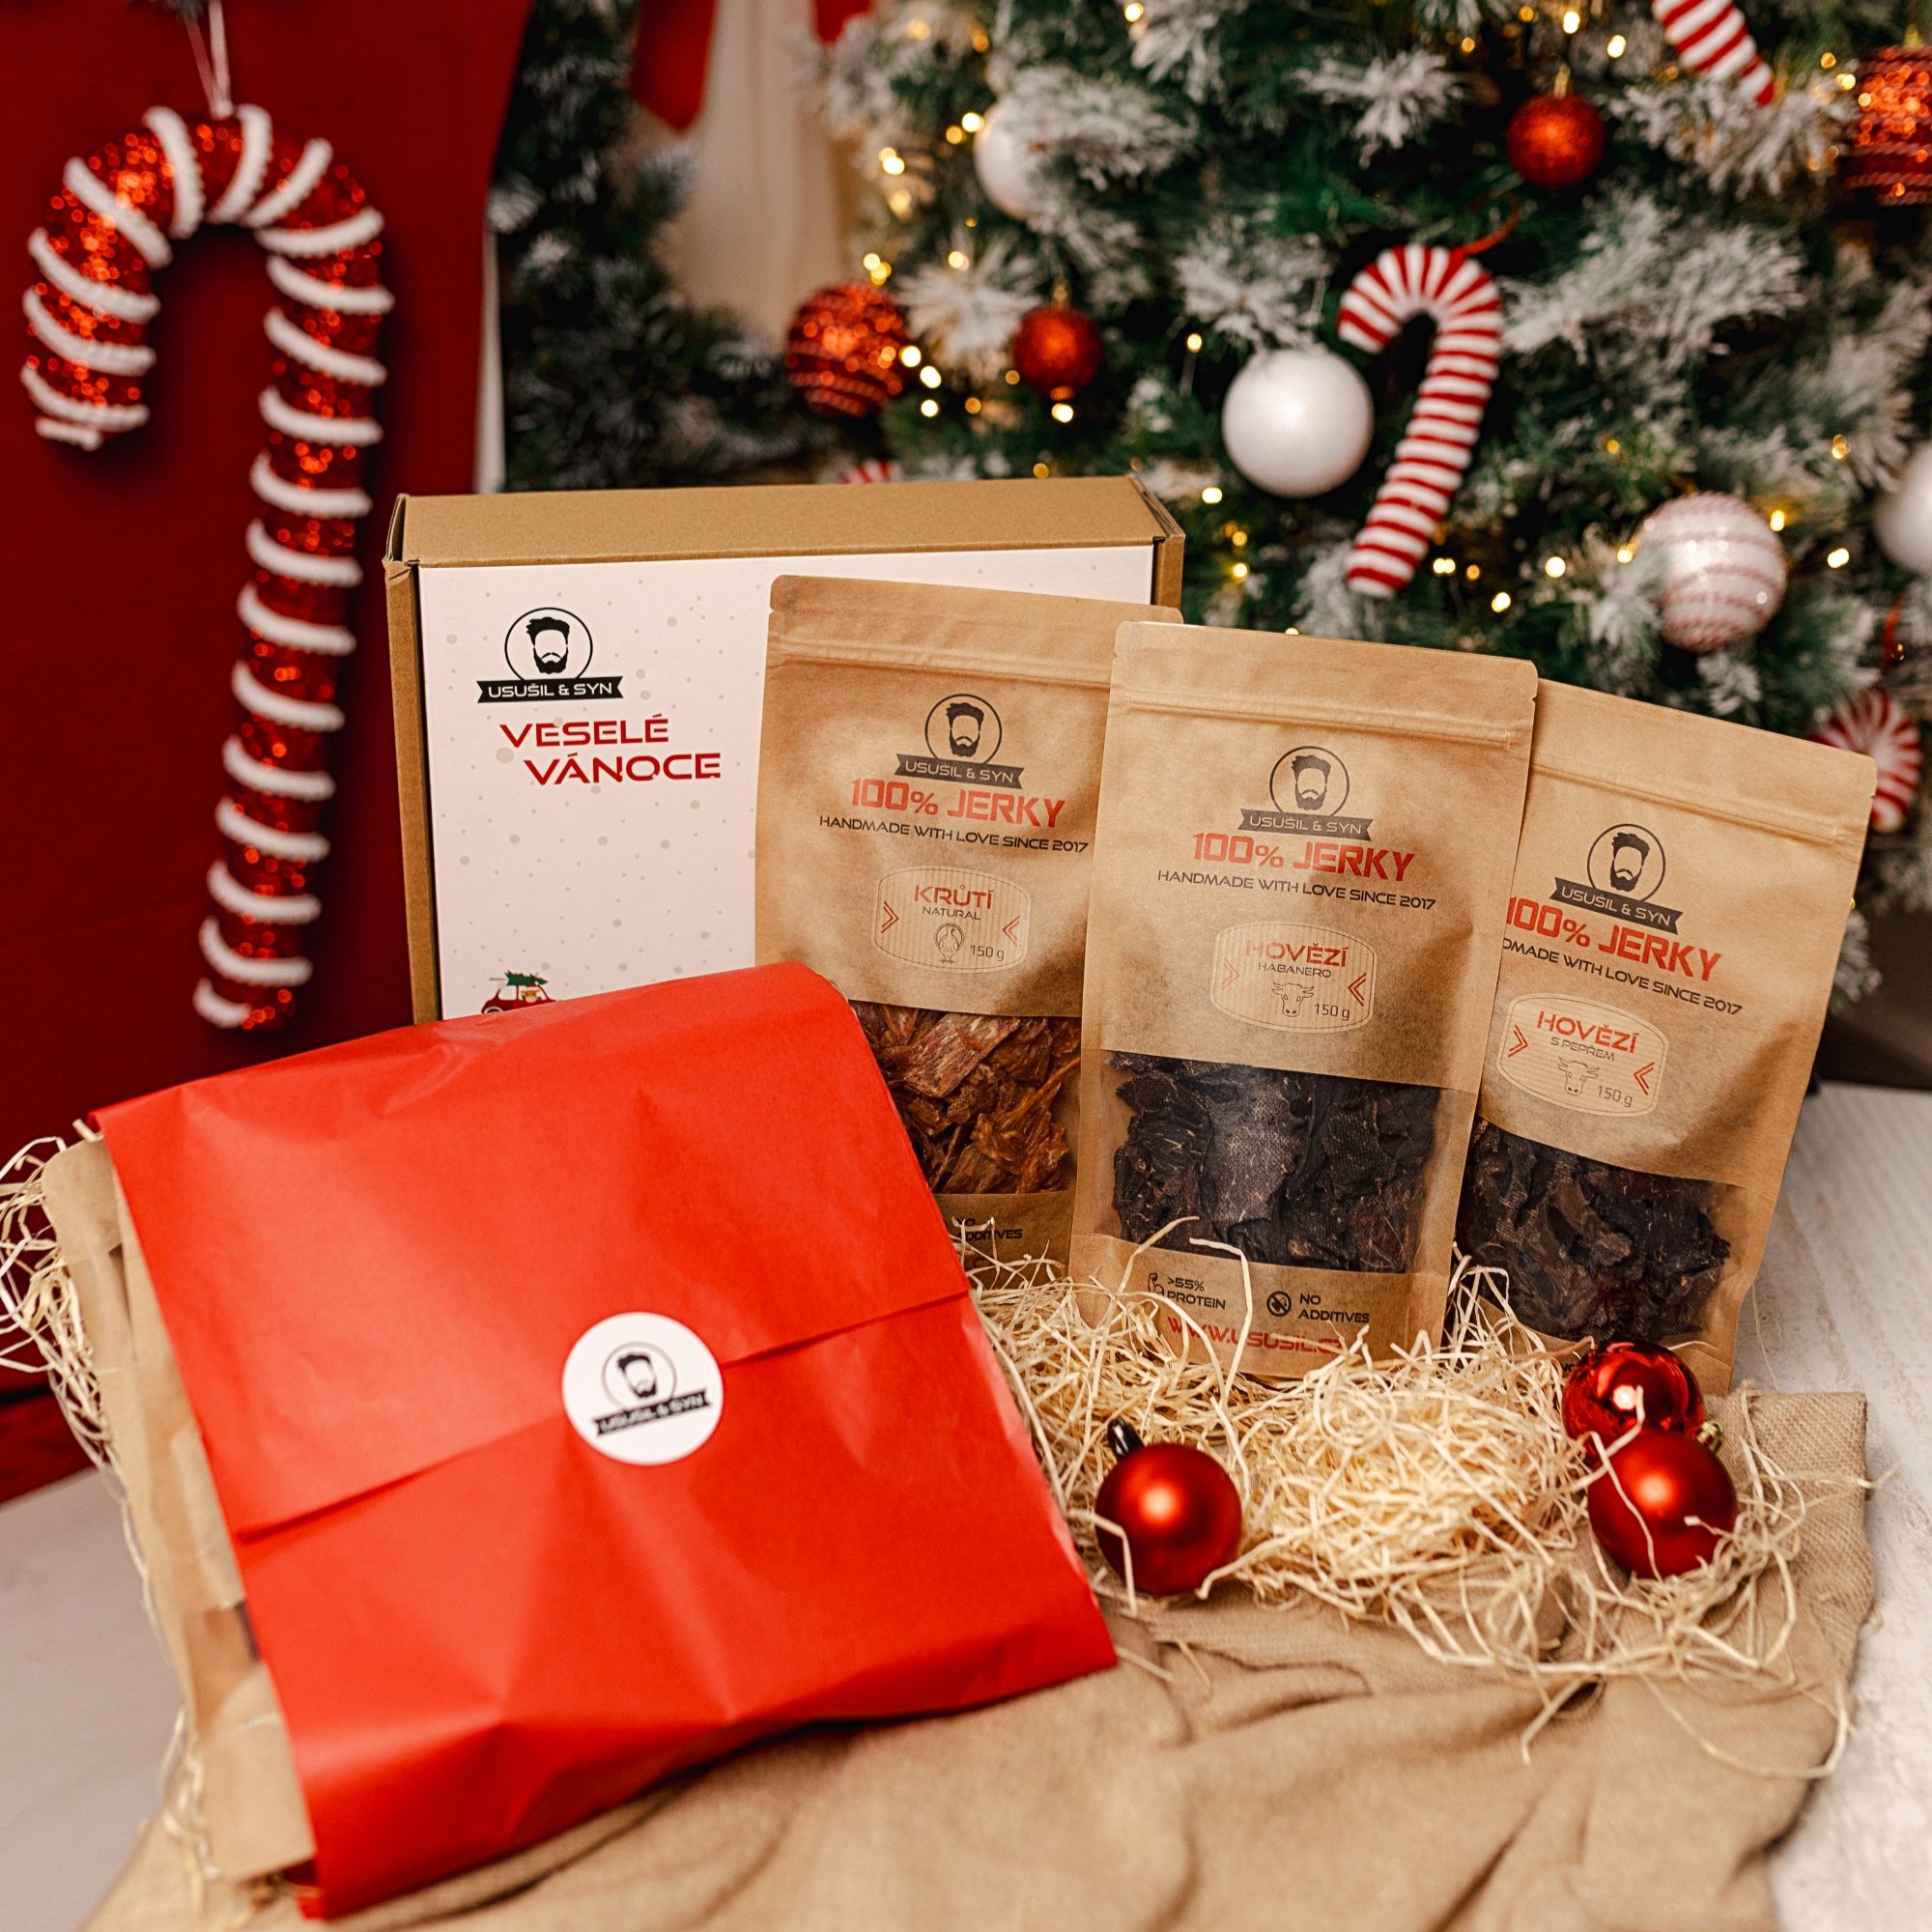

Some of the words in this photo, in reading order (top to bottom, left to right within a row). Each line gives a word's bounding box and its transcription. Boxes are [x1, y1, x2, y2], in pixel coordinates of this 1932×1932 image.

[488, 683, 554, 698] USUŠIL
[558, 684, 569, 696] &
[574, 682, 612, 696] SYN
[499, 713, 668, 748] VESELÉ
[524, 753, 721, 785] VÁNOCE
[966, 768, 976, 779] &
[980, 770, 1013, 782] SYN
[851, 778, 939, 815] 100%
[947, 788, 1065, 828] JERKY
[819, 815, 910, 836] HANDMADE
[914, 825, 953, 840] WITH
[956, 830, 1000, 846] LOVE
[1003, 836, 1049, 850] SINCE
[1051, 840, 1089, 853] 2017
[1250, 815, 1308, 831] USUŠIL
[1312, 820, 1322, 832] &
[1326, 821, 1362, 835] SYN
[1192, 832, 1284, 868] 100%
[1293, 840, 1415, 882] JERKY
[914, 884, 994, 909] KRŮTÍ
[1157, 869, 1254, 889] HANDMADE
[1258, 878, 1298, 894] WITH
[1302, 882, 1346, 899] LOVE
[1350, 889, 1397, 906] SINCE
[1399, 895, 1436, 910] 2017
[922, 906, 980, 920] NATURAL
[1561, 886, 1617, 912] USUŠIL
[1621, 903, 1632, 916] &
[1634, 907, 1671, 926] SYN
[1506, 896, 1591, 948] 100%
[1598, 924, 1722, 982] JERKY
[970, 945, 993, 957] 150
[996, 950, 1005, 961] g
[1245, 939, 1349, 967] HOVĚZÍ
[1258, 962, 1332, 979] HABANERO
[1502, 937, 1559, 964] DMADE
[1563, 954, 1603, 976] WITH
[1605, 967, 1649, 989] LOVE
[1653, 981, 1700, 1005] SINCE
[1703, 996, 1743, 1015] 2017
[1314, 1003, 1339, 1017] 150
[1342, 1009, 1350, 1021] g
[1537, 1010, 1639, 1053] HOVĚZÍ
[1550, 1037, 1560, 1046] S
[1598, 1086, 1622, 1102] 150
[1624, 1095, 1633, 1108] g
[1167, 1276, 1205, 1293] >55%
[1167, 1290, 1226, 1310] PROTEIN
[1299, 1293, 1321, 1305] NO
[1298, 1309, 1370, 1323] ADDITIVES
